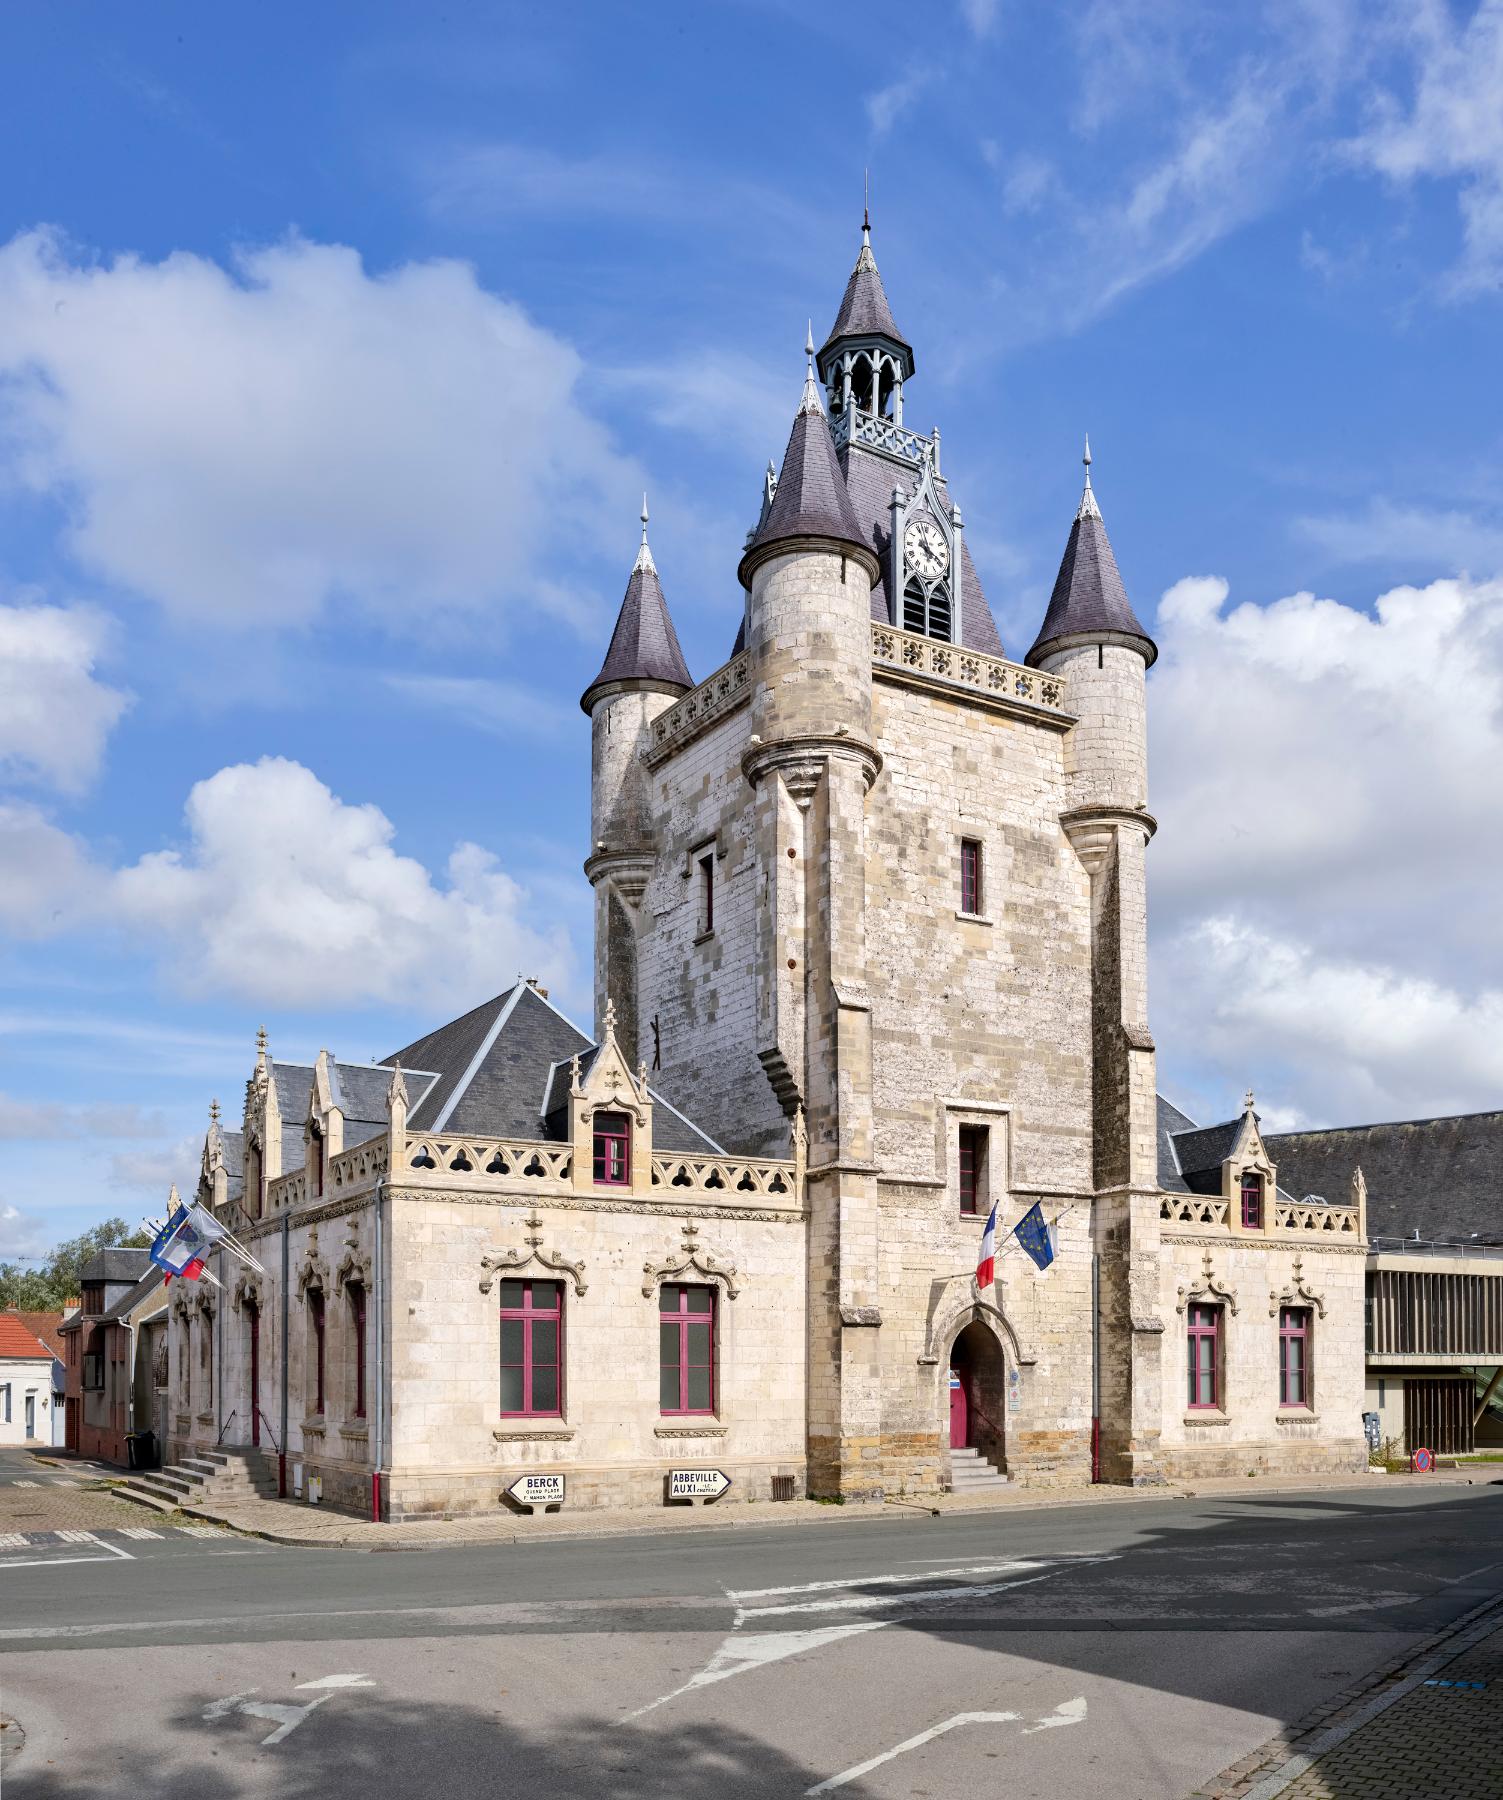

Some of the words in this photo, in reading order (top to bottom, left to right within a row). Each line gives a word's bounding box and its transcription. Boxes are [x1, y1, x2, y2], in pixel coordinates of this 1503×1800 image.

[673, 1473, 718, 1482] ABBEVILLE
[527, 1478, 559, 1488] BERCK
[673, 1484, 696, 1493] AUXI
